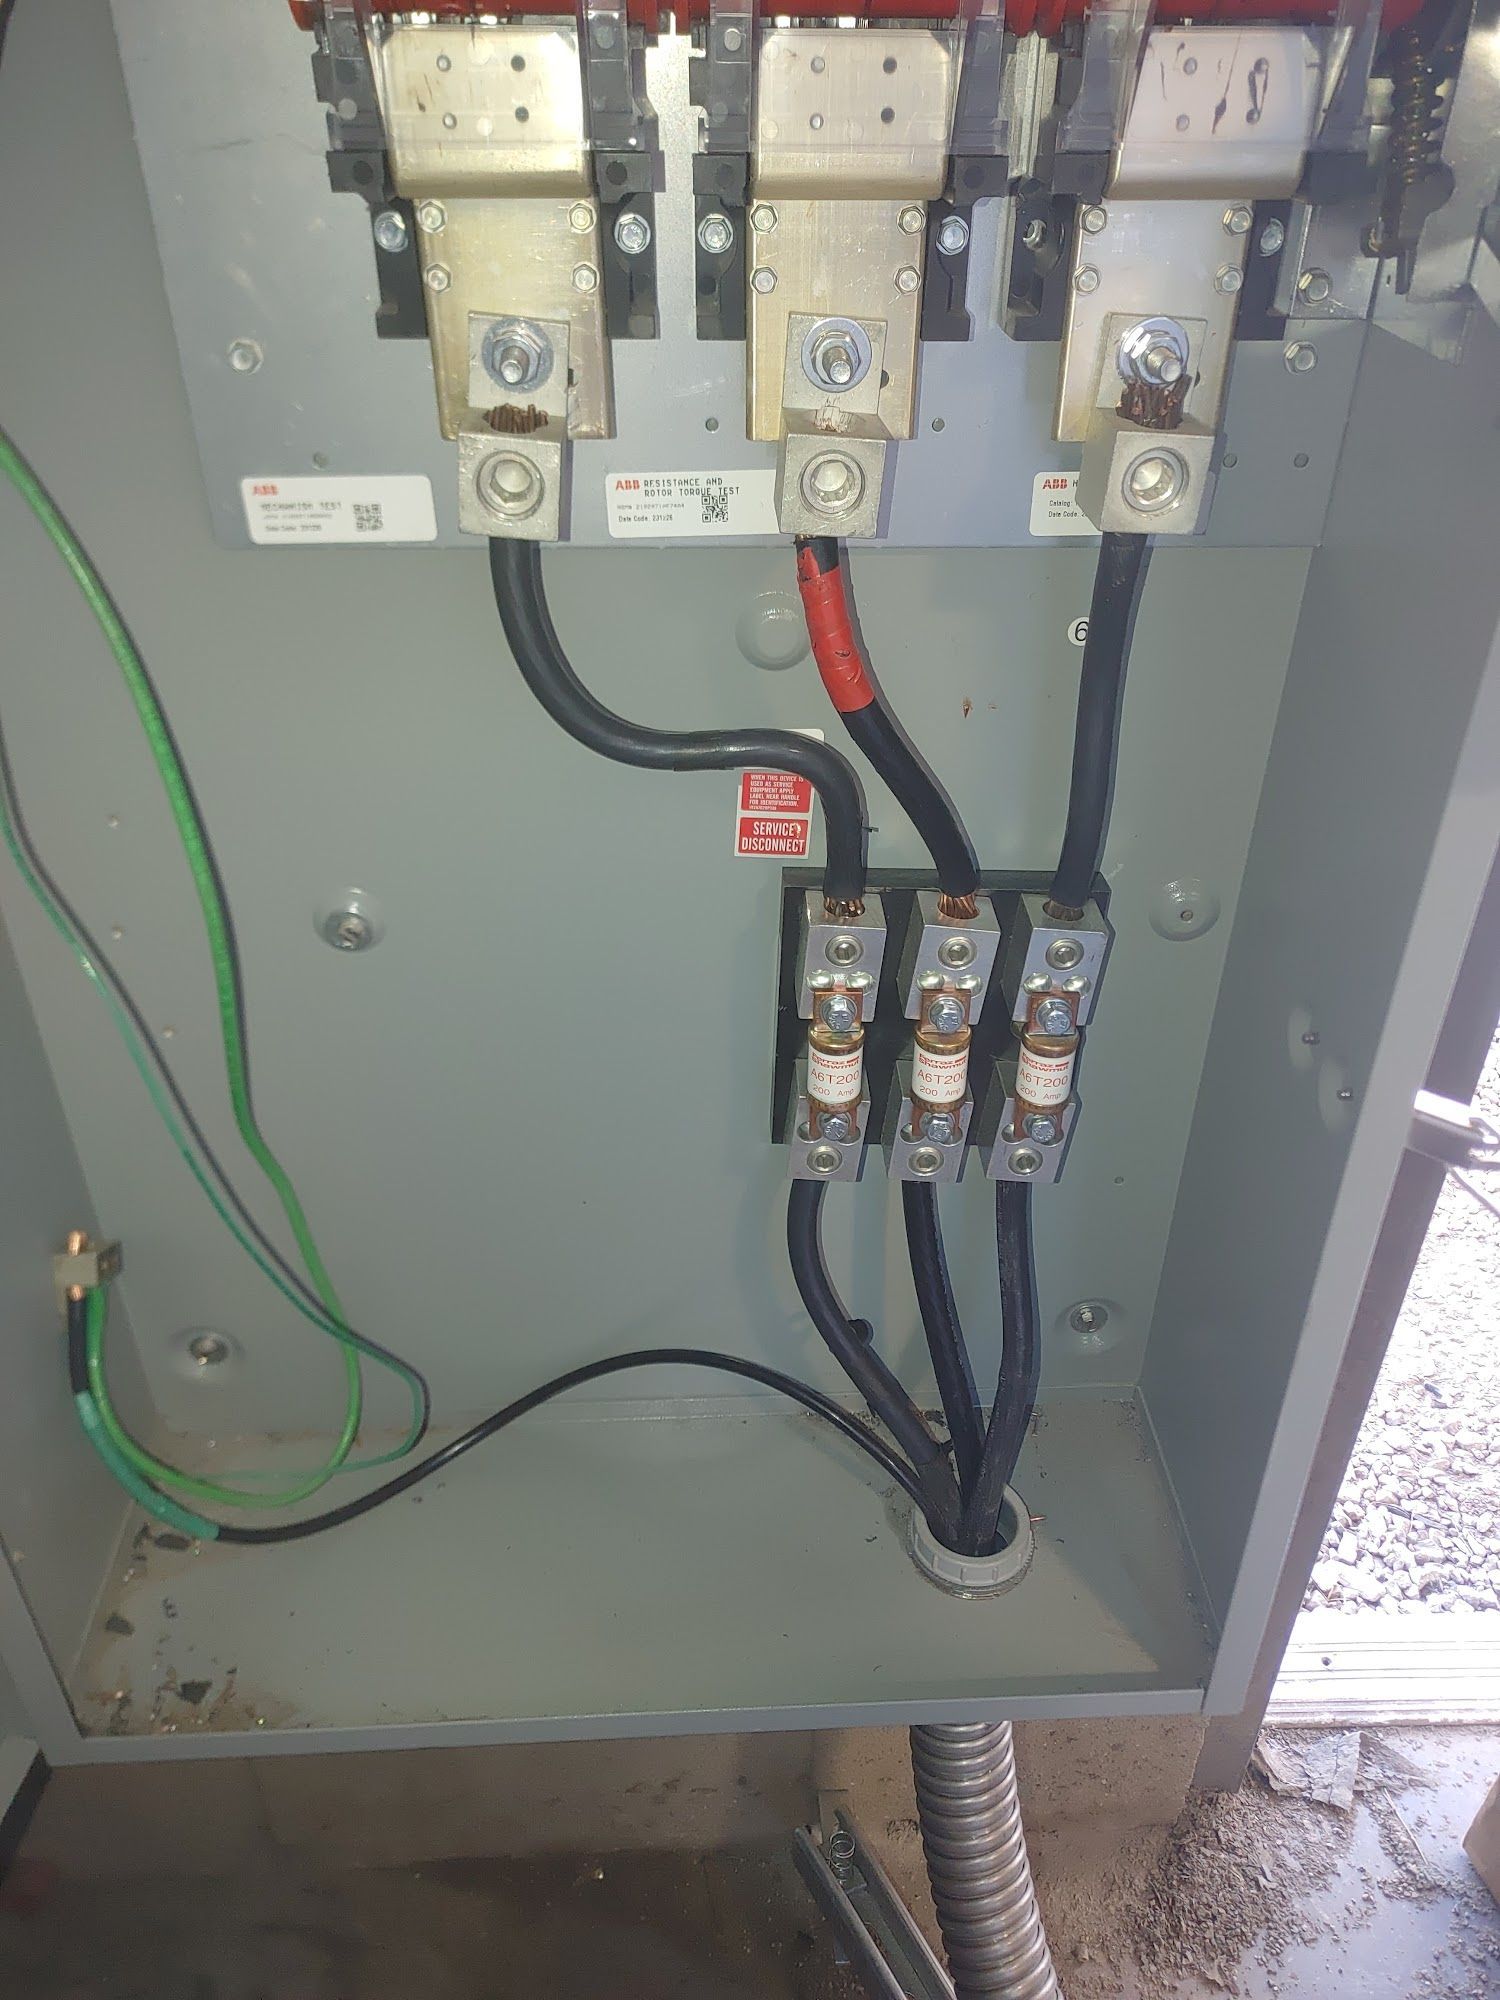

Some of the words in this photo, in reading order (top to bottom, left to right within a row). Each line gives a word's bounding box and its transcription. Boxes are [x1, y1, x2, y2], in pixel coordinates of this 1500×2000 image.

[615, 479, 640, 490] ABB
[644, 478, 700, 488] RESISTANCE
[706, 477, 723, 486] AND
[1043, 479, 1067, 489] ABB
[644, 488, 673, 497] ROTOR
[679, 488, 711, 496] TORQUE
[718, 486, 741, 496] TEST
[1075, 621, 1089, 642] 6
[767, 774, 778, 782] THIS
[750, 786, 778, 794] EQUIPMENT
[753, 821, 794, 836] SERVICE
[741, 837, 805, 852] DISCONNECT
[811, 1056, 860, 1070] Shawmut
[812, 1051, 846, 1064] Ferraz
[918, 1052, 954, 1066] Ferraz
[918, 1057, 968, 1070] Shawmut
[1021, 1056, 1070, 1072] Shawmut
[1022, 1052, 1054, 1068] Ferraz
[810, 1068, 860, 1085] A6T200
[917, 1068, 967, 1085] A6T200
[1019, 1068, 1068, 1088] A6T200
[812, 1084, 831, 1096] 200
[919, 1085, 938, 1097] 200
[1020, 1084, 1038, 1098] 200
